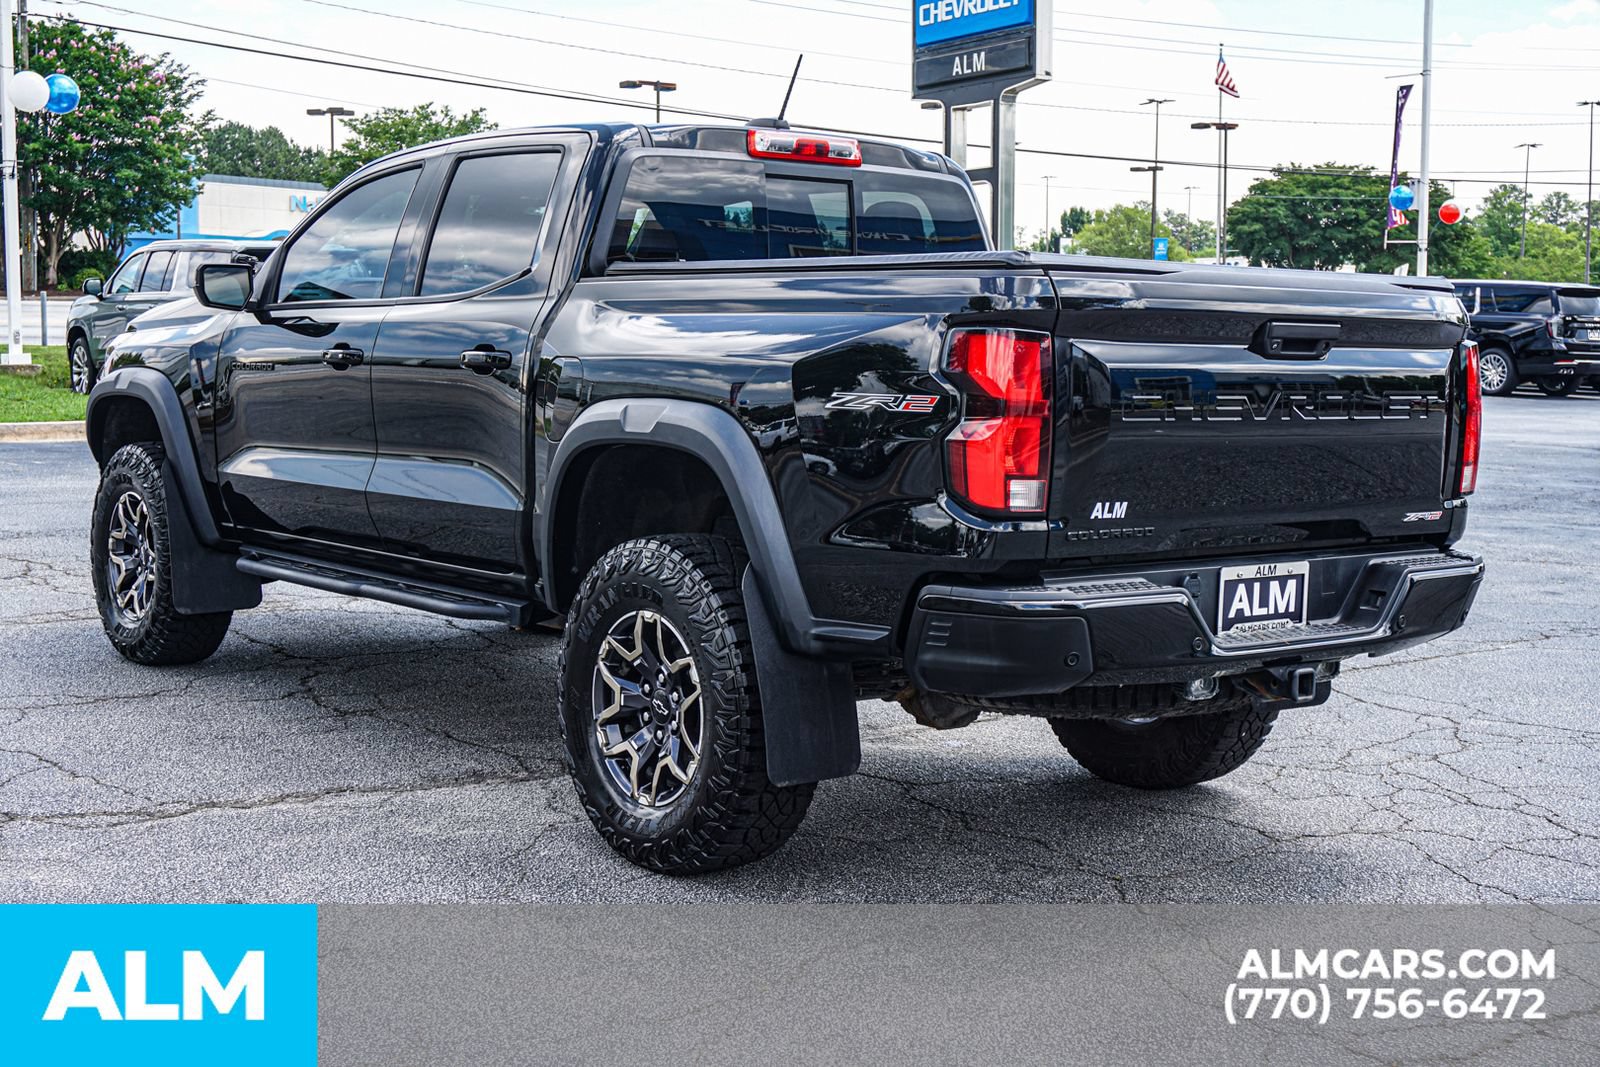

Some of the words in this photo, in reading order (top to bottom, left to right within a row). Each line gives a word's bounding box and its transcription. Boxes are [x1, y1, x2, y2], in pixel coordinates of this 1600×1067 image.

[919, 0, 1019, 26] CHEVROL
[952, 51, 985, 76] ALM
[824, 392, 940, 412] ZR2
[1121, 390, 1439, 421] CHEVROLET
[1090, 501, 1128, 519] ALM
[1066, 526, 1155, 541] COLORADO
[1255, 564, 1277, 577] ALM
[1227, 579, 1297, 619] ALM
[1239, 621, 1287, 633] ALMCARSCOM
